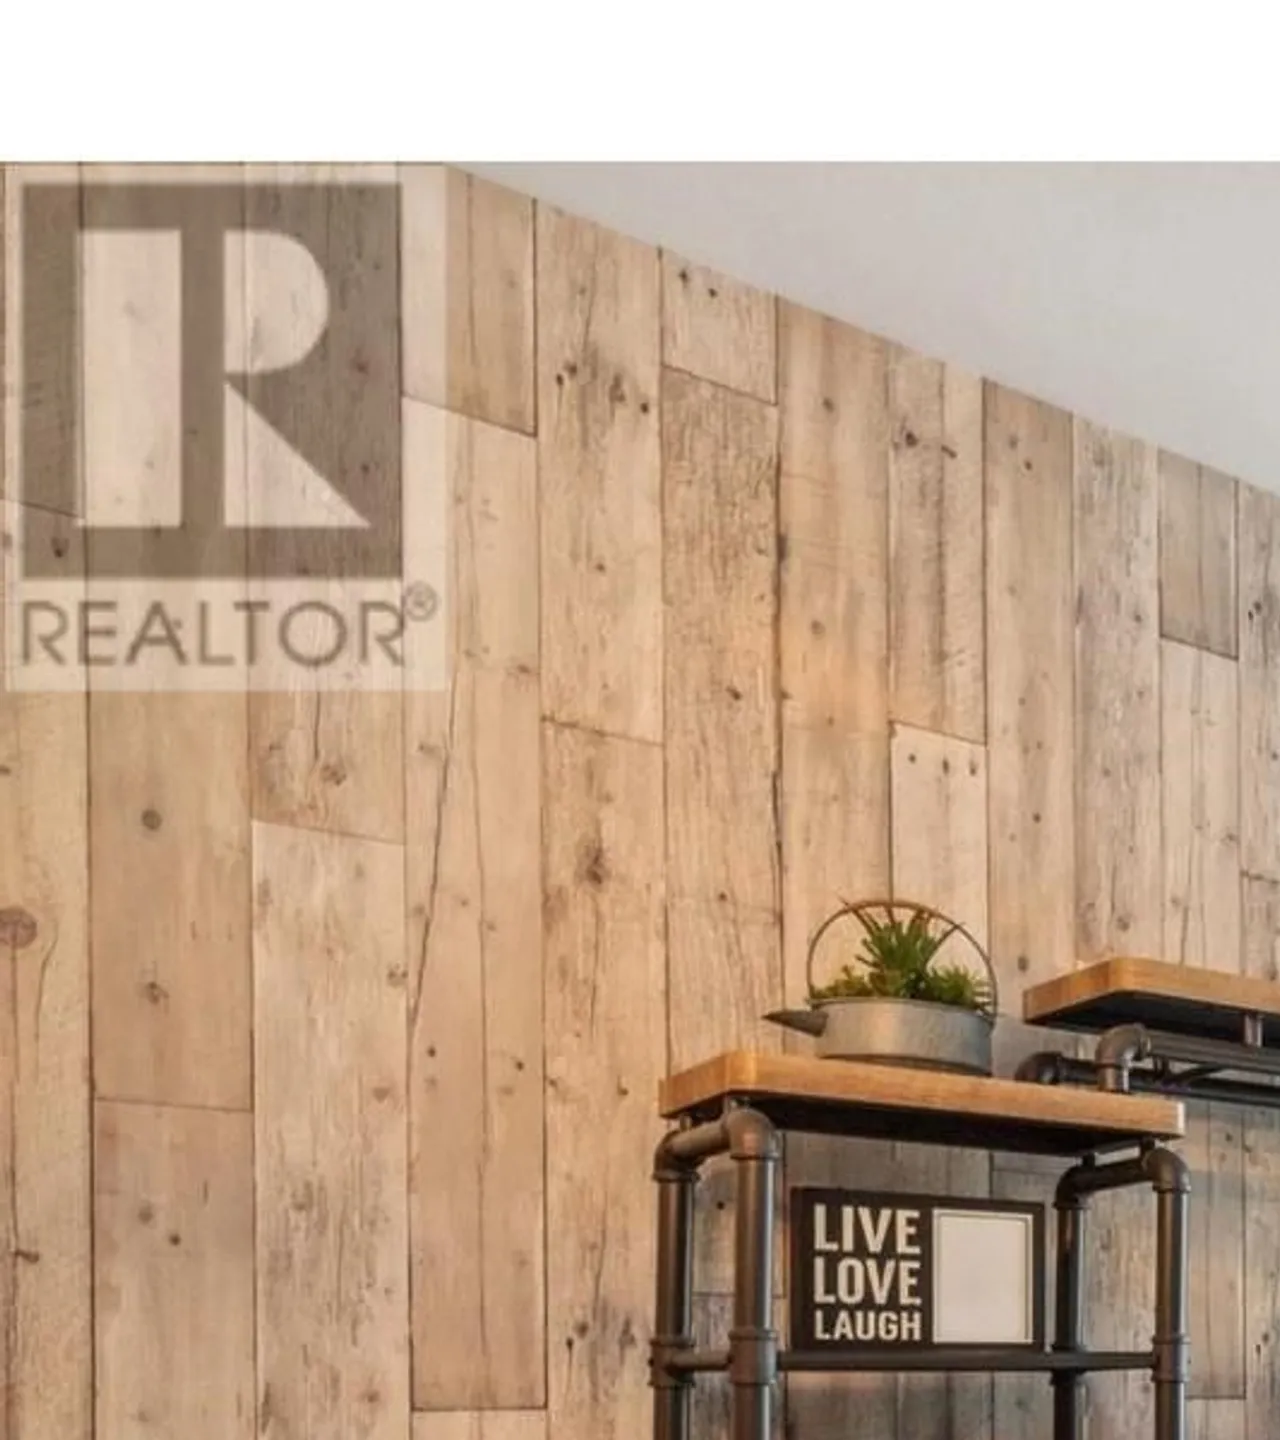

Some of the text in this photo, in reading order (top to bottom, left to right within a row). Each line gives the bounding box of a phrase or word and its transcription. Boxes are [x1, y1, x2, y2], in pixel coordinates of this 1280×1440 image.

[813, 1203, 922, 1254] LIVE
[813, 1256, 922, 1305] LOVE
[814, 1310, 922, 1341] LAUGH
